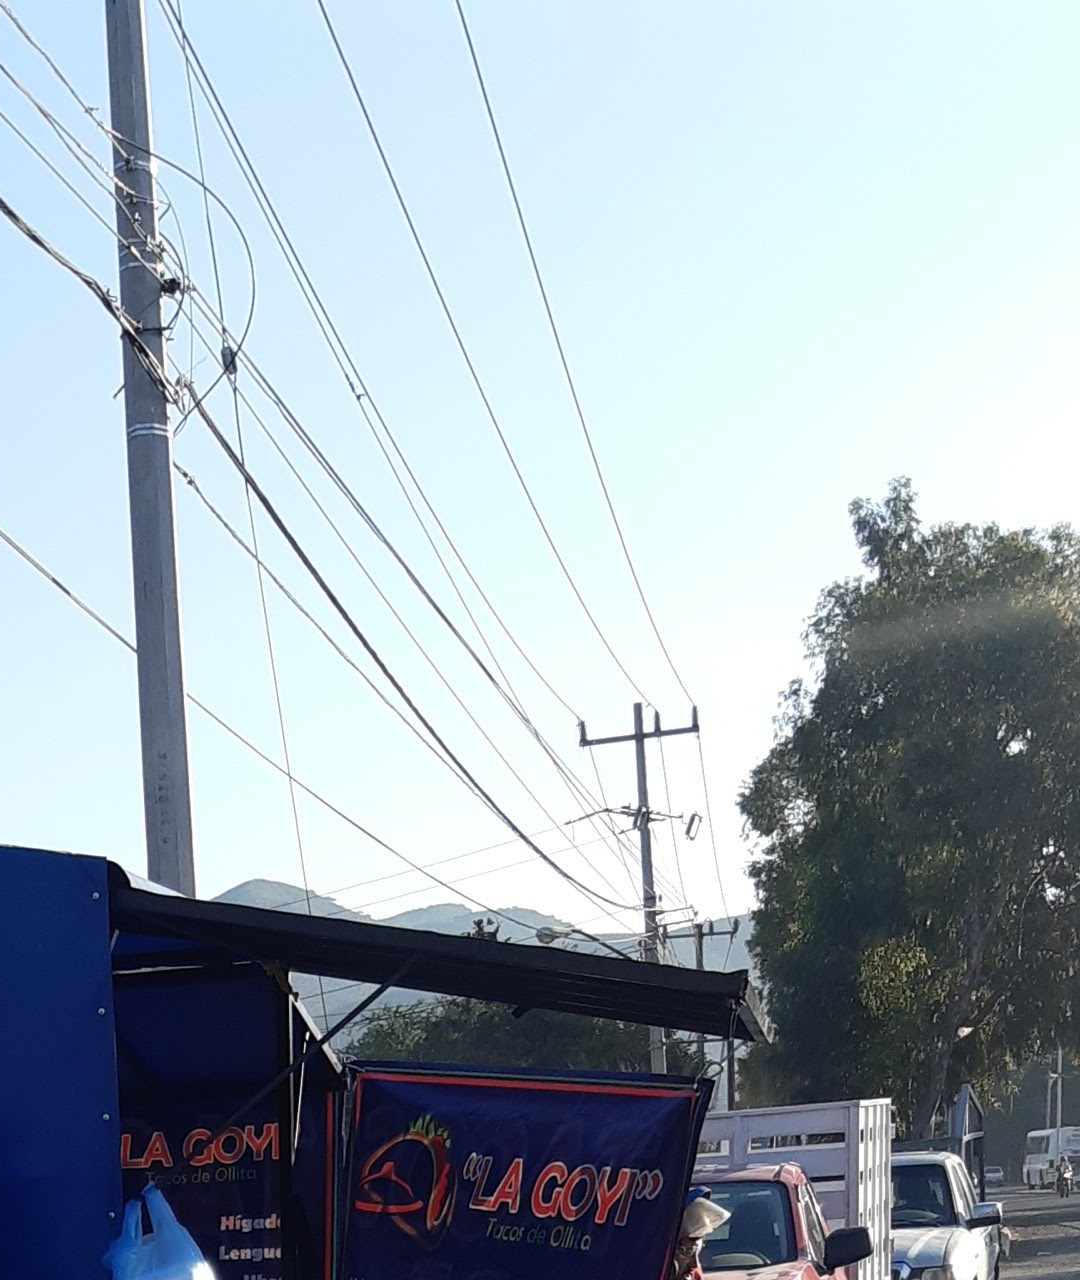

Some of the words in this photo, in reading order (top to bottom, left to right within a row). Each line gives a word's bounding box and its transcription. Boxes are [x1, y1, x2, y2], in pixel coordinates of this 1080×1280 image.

[120, 1131, 174, 1169] LA
[183, 1122, 281, 1167] GOYI
[192, 1169, 211, 1184] de
[485, 1216, 526, 1242] Tacos
[526, 1224, 547, 1245] de
[549, 1225, 593, 1251] Ollita
